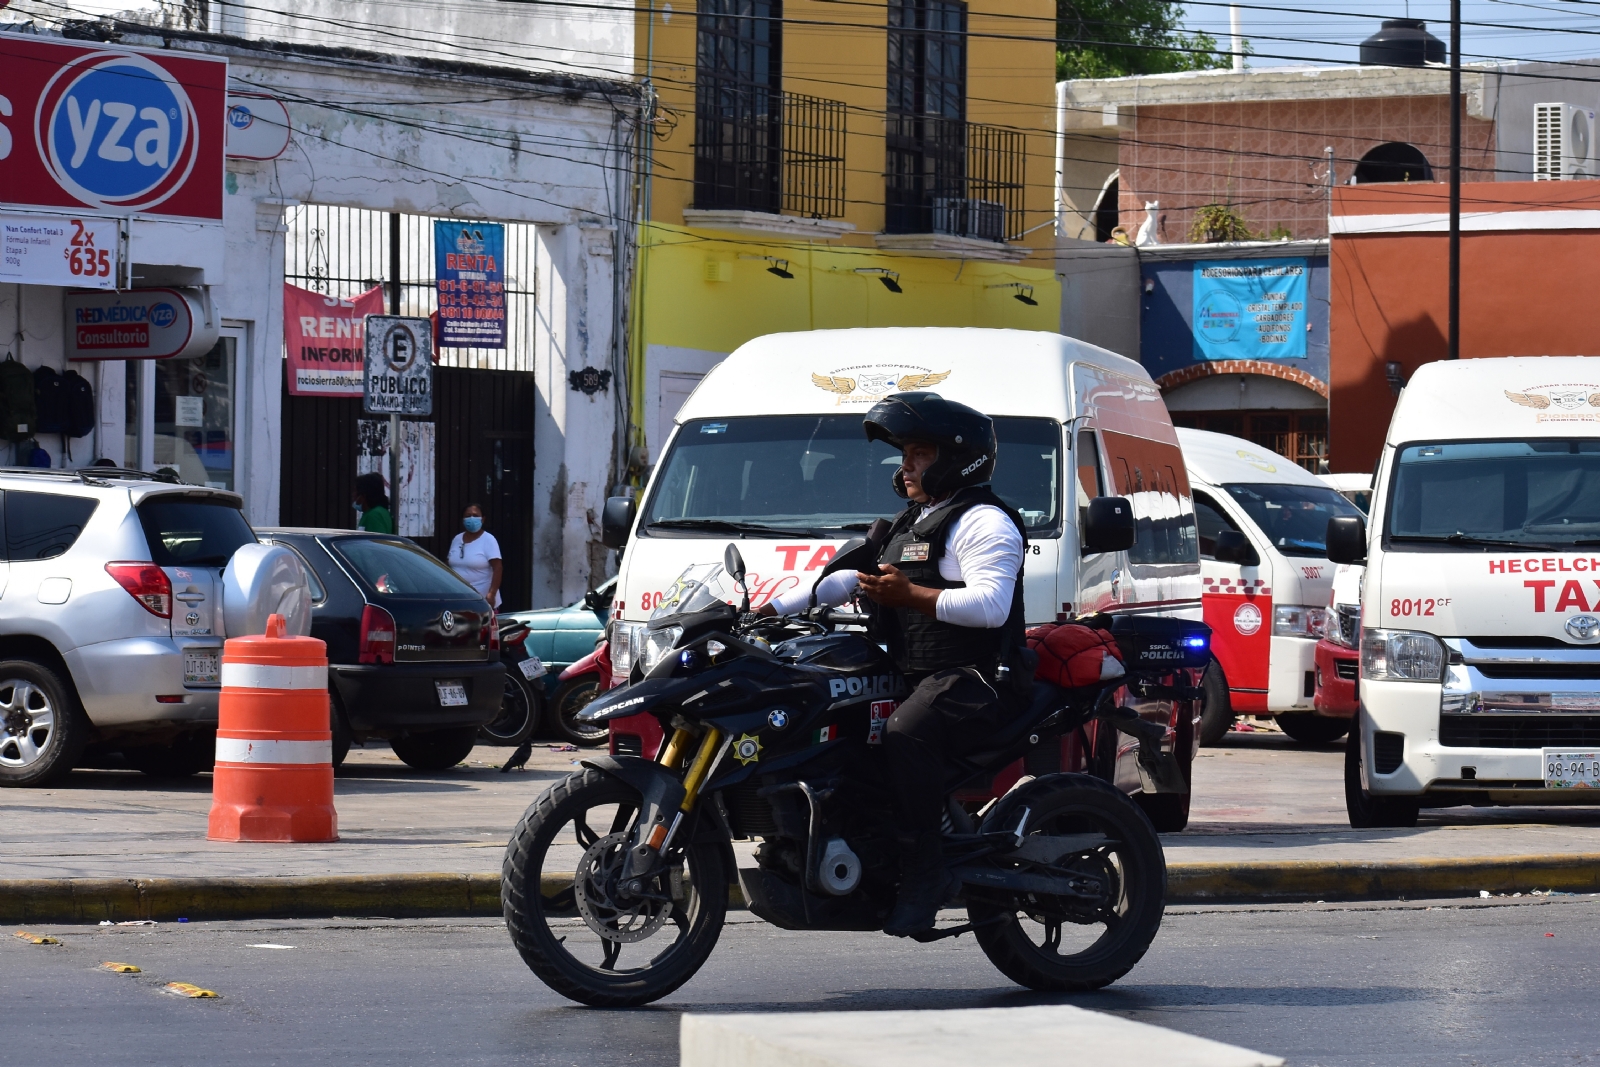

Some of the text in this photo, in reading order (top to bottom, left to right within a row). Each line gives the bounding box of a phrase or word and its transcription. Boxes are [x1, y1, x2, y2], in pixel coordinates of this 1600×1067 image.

[231, 111, 250, 124] yza
[67, 95, 171, 169] yza
[6, 225, 19, 233] Nan
[20, 226, 42, 235] Confort
[43, 227, 59, 236] Total
[70, 219, 94, 247] 2x
[6, 235, 51, 246] Fórmula Infantil
[6, 246, 28, 255] Etapa 3
[5, 256, 21, 267] 900g
[446, 252, 497, 273] RENTA
[1201, 265, 1304, 278] ACCESORIOS PARA CELULARES
[152, 308, 174, 323] yza
[1271, 302, 1303, 311] TEMPLADO
[300, 316, 364, 338] RENT
[77, 328, 147, 345] Consultorio
[301, 346, 363, 363] INFORM
[297, 375, 364, 387] rociosierra80@hotm
[371, 375, 427, 395] PUBLICO
[960, 454, 989, 477] RODA
[775, 545, 841, 571] TA
[641, 591, 663, 611] 80
[1524, 580, 1600, 612] TA
[1390, 598, 1436, 617] 8012
[593, 697, 645, 719] SSPCAM
